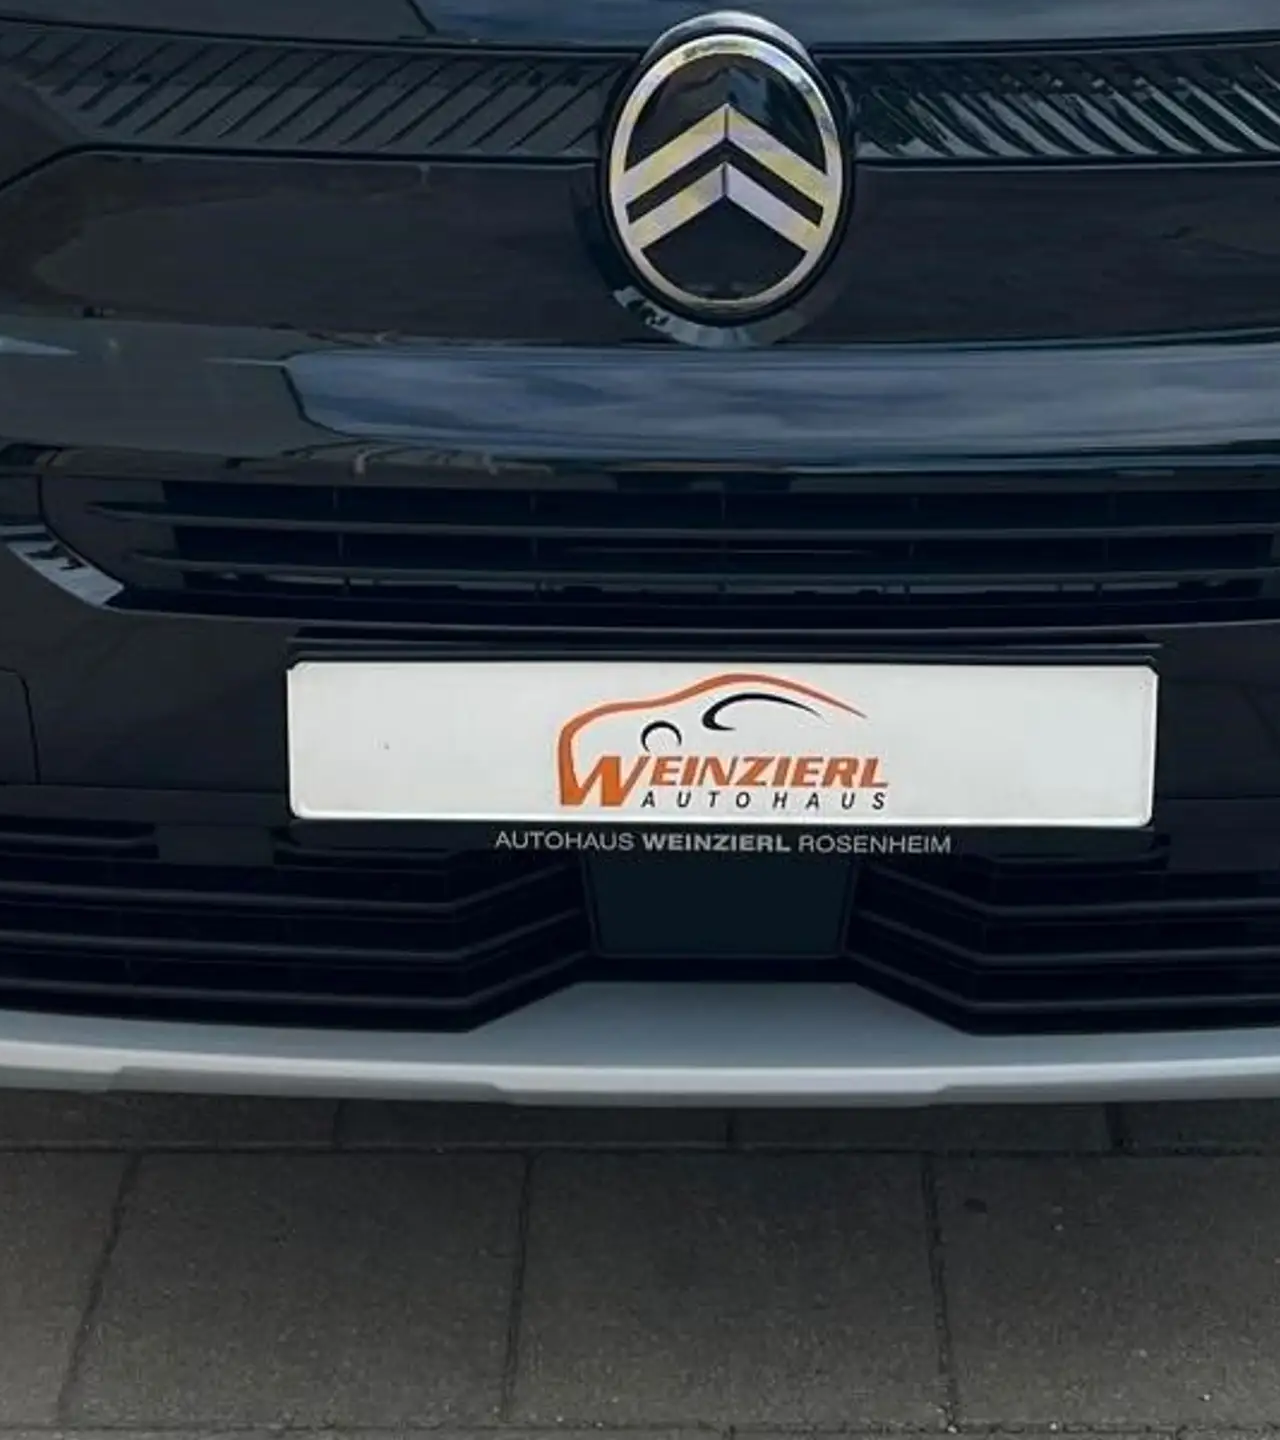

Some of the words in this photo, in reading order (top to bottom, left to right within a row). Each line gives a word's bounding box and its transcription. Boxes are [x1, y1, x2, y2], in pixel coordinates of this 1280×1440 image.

[557, 755, 889, 808] WEINZIERL
[639, 790, 887, 810] AUTOHAUS
[494, 830, 634, 851] AUTOHAUS
[641, 832, 791, 854] WEINZIERL
[797, 833, 952, 855] ROSENHEIM
